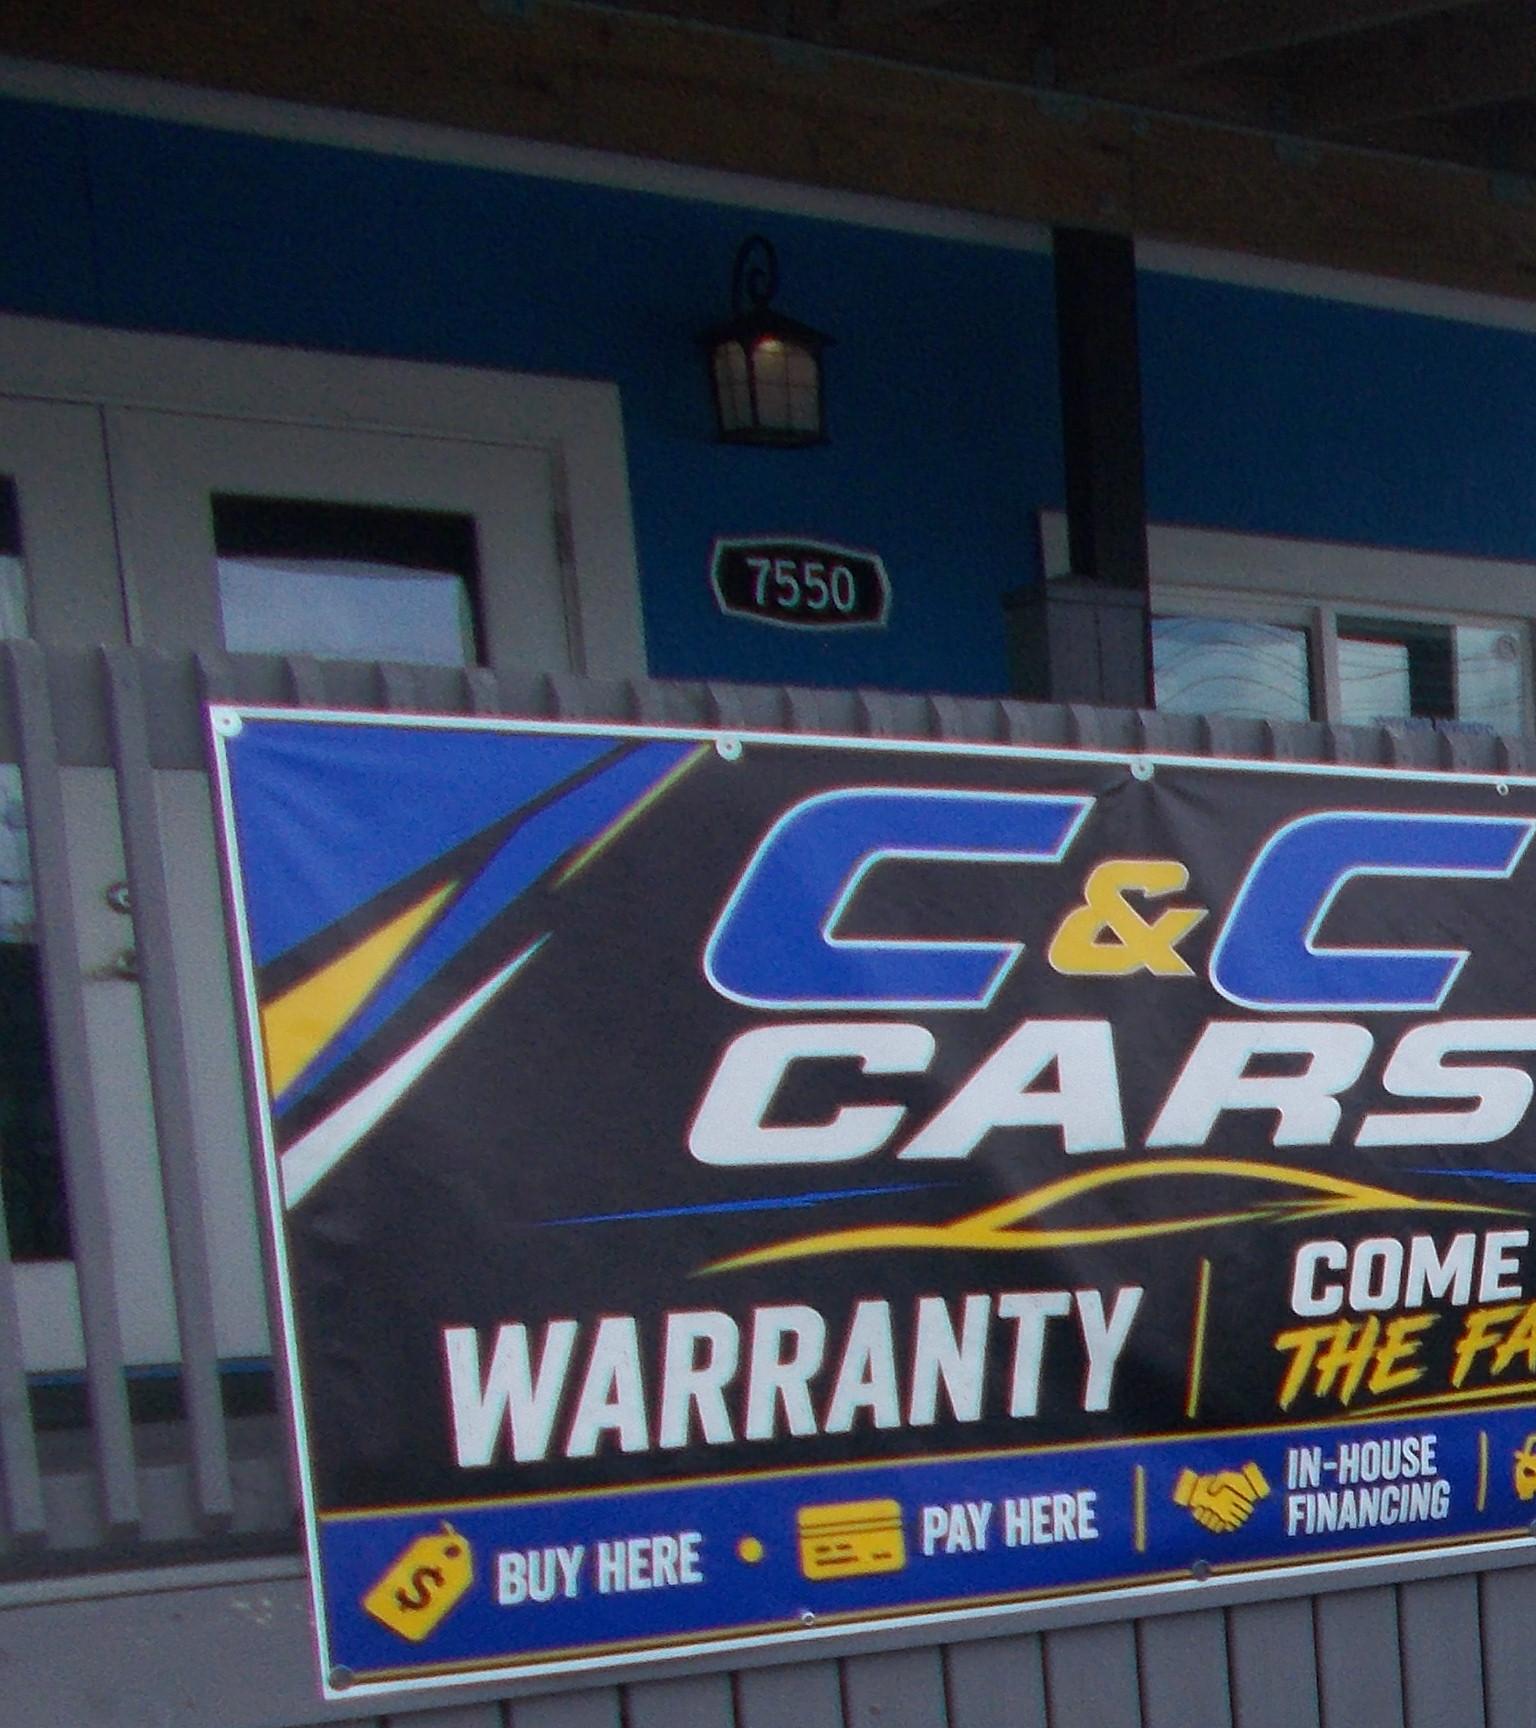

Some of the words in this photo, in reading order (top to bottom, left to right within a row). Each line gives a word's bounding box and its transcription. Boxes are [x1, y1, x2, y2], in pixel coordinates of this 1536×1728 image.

[747, 557, 857, 614] 7550
[1289, 1228, 1531, 1318] COME
[441, 1285, 1144, 1469] WARRANTY
[1273, 1312, 1442, 1412] THE
[1286, 1434, 1440, 1491] IN-HOUSE
[922, 1500, 994, 1557] PAY
[1005, 1490, 1100, 1548] HERE
[1286, 1480, 1451, 1538] FINANCING
[498, 1547, 586, 1606] BUY
[599, 1532, 704, 1595] HERE
